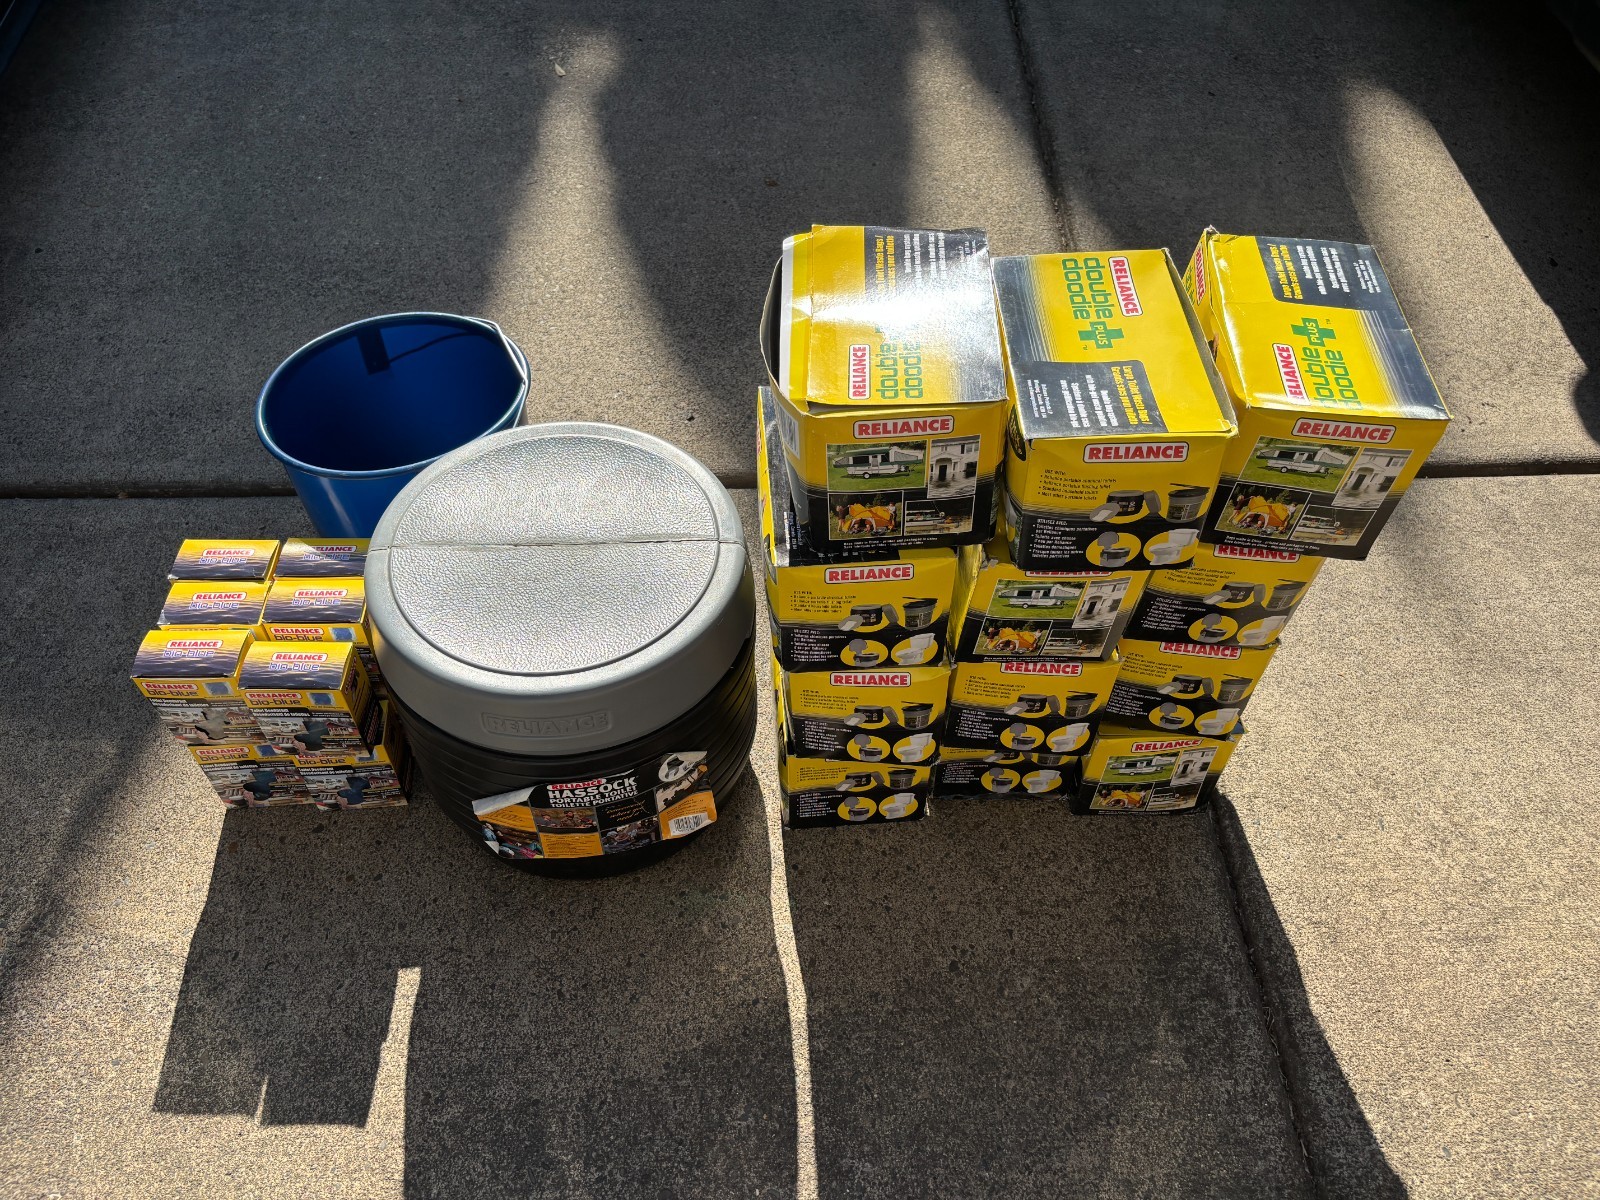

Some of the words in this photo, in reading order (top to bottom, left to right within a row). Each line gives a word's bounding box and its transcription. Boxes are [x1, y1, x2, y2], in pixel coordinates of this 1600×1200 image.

[1062, 259, 1092, 319] doodie
[1083, 258, 1114, 319] double
[1113, 260, 1138, 314] RELIANCE
[1094, 325, 1108, 345] PLUS
[1306, 322, 1320, 342] PLUS
[853, 346, 866, 397] RELIANCE
[1123, 366, 1135, 379] Large
[1127, 380, 1141, 394] Toilet
[1132, 394, 1145, 409] Waste
[1138, 409, 1150, 421] Bags
[857, 419, 950, 437] RELIANCE
[1297, 422, 1392, 441] RELIANCE
[1088, 445, 1185, 461] RELIANCE
[1218, 545, 1297, 560] RELIANCE
[829, 567, 911, 581] RELIANCE
[292, 598, 341, 606] bio-blue
[164, 649, 215, 657] bio-blue
[1163, 642, 1239, 657] RELIANCE
[269, 663, 320, 672] bio-blue
[1004, 662, 1079, 674] RELIANCE
[834, 675, 908, 685] RELIANCE
[487, 713, 608, 735] RELIANCE
[1135, 739, 1200, 751] RELIANCE
[201, 754, 249, 762] bio-blue
[548, 776, 636, 798] HASSOCK
[551, 779, 603, 790] RELIANCE
[550, 794, 594, 804] PORTABLE
[596, 786, 638, 801] TOILET
[551, 800, 591, 808] TOILETTE
[593, 790, 638, 806] PORTATIVE
